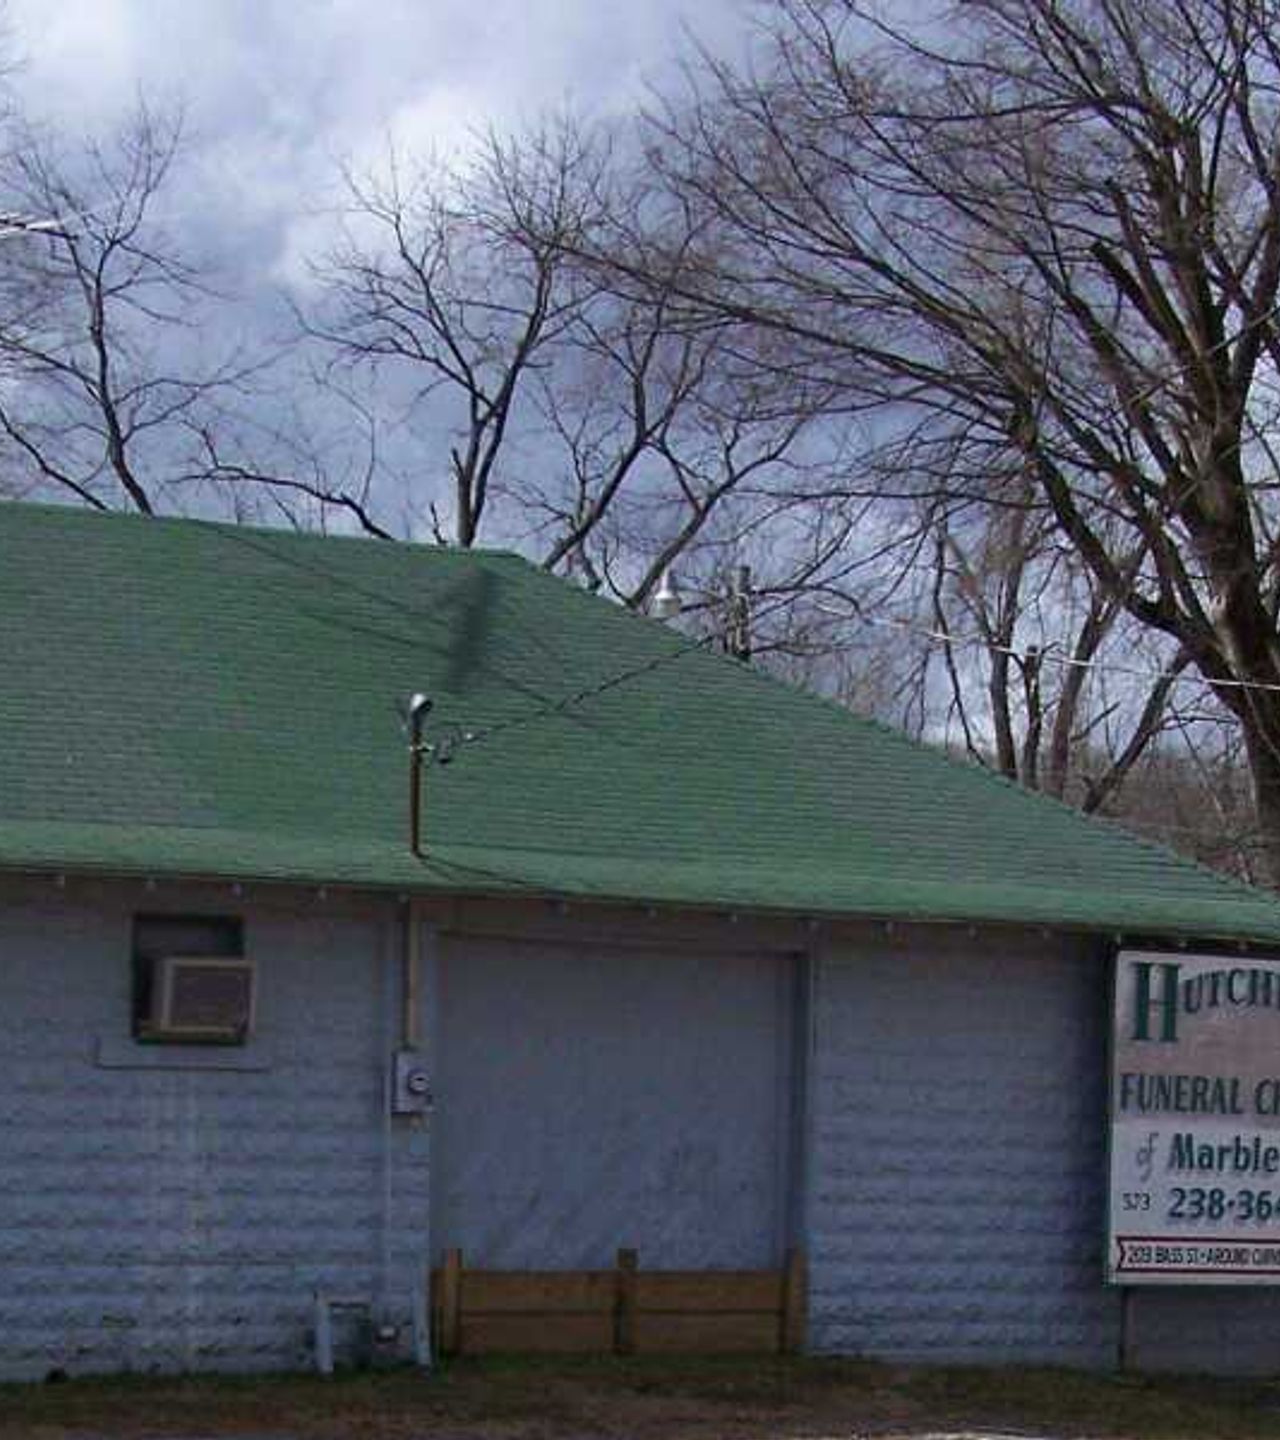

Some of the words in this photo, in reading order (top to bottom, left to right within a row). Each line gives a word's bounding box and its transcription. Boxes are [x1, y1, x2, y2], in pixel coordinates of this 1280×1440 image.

[1120, 1072, 1245, 1116] FUNERAL
[1135, 1131, 1160, 1183] of
[1167, 1131, 1280, 1174] Marble
